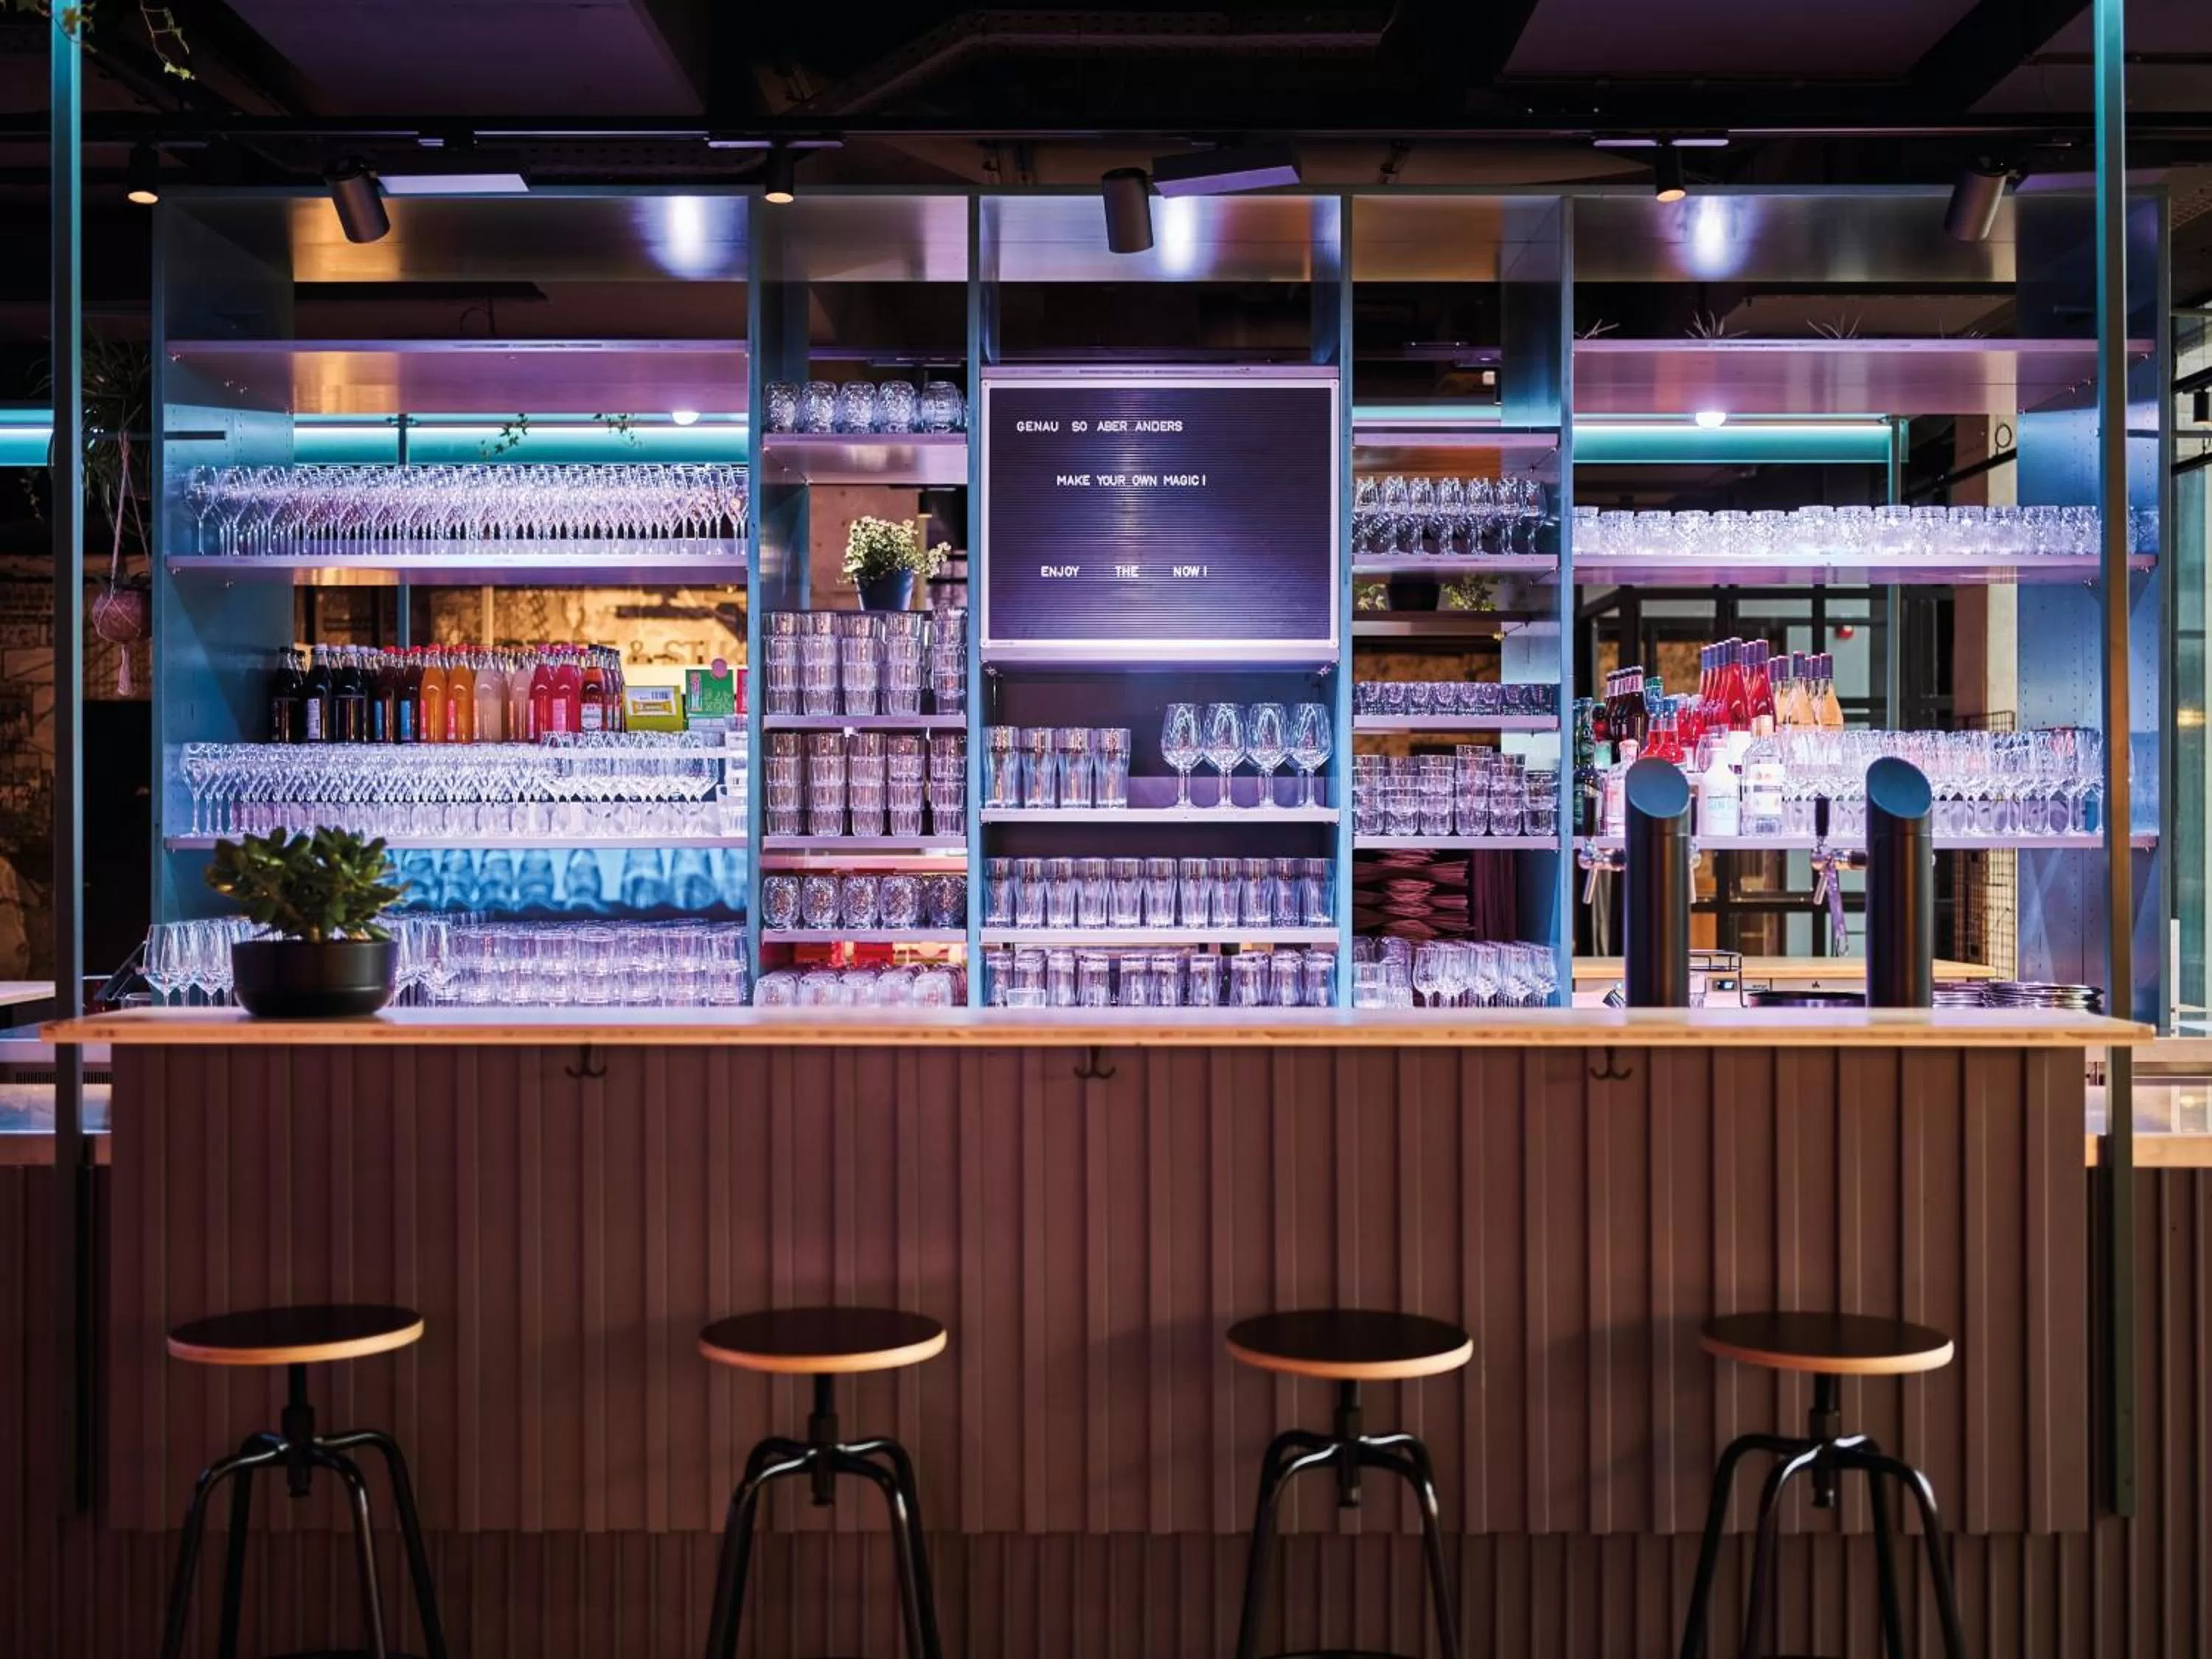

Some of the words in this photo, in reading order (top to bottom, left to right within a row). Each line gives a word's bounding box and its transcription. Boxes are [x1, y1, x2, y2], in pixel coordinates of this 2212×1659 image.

[1017, 420, 1059, 431] GENAU
[1071, 420, 1088, 431] SO
[1096, 420, 1127, 431] ABER
[1135, 420, 1183, 431] ANDERS
[1057, 475, 1091, 486] MAKE
[1096, 475, 1126, 486] YOUR
[1132, 475, 1157, 486] OWN
[1040, 565, 1079, 577] ENJOY
[1115, 565, 1139, 577] THE
